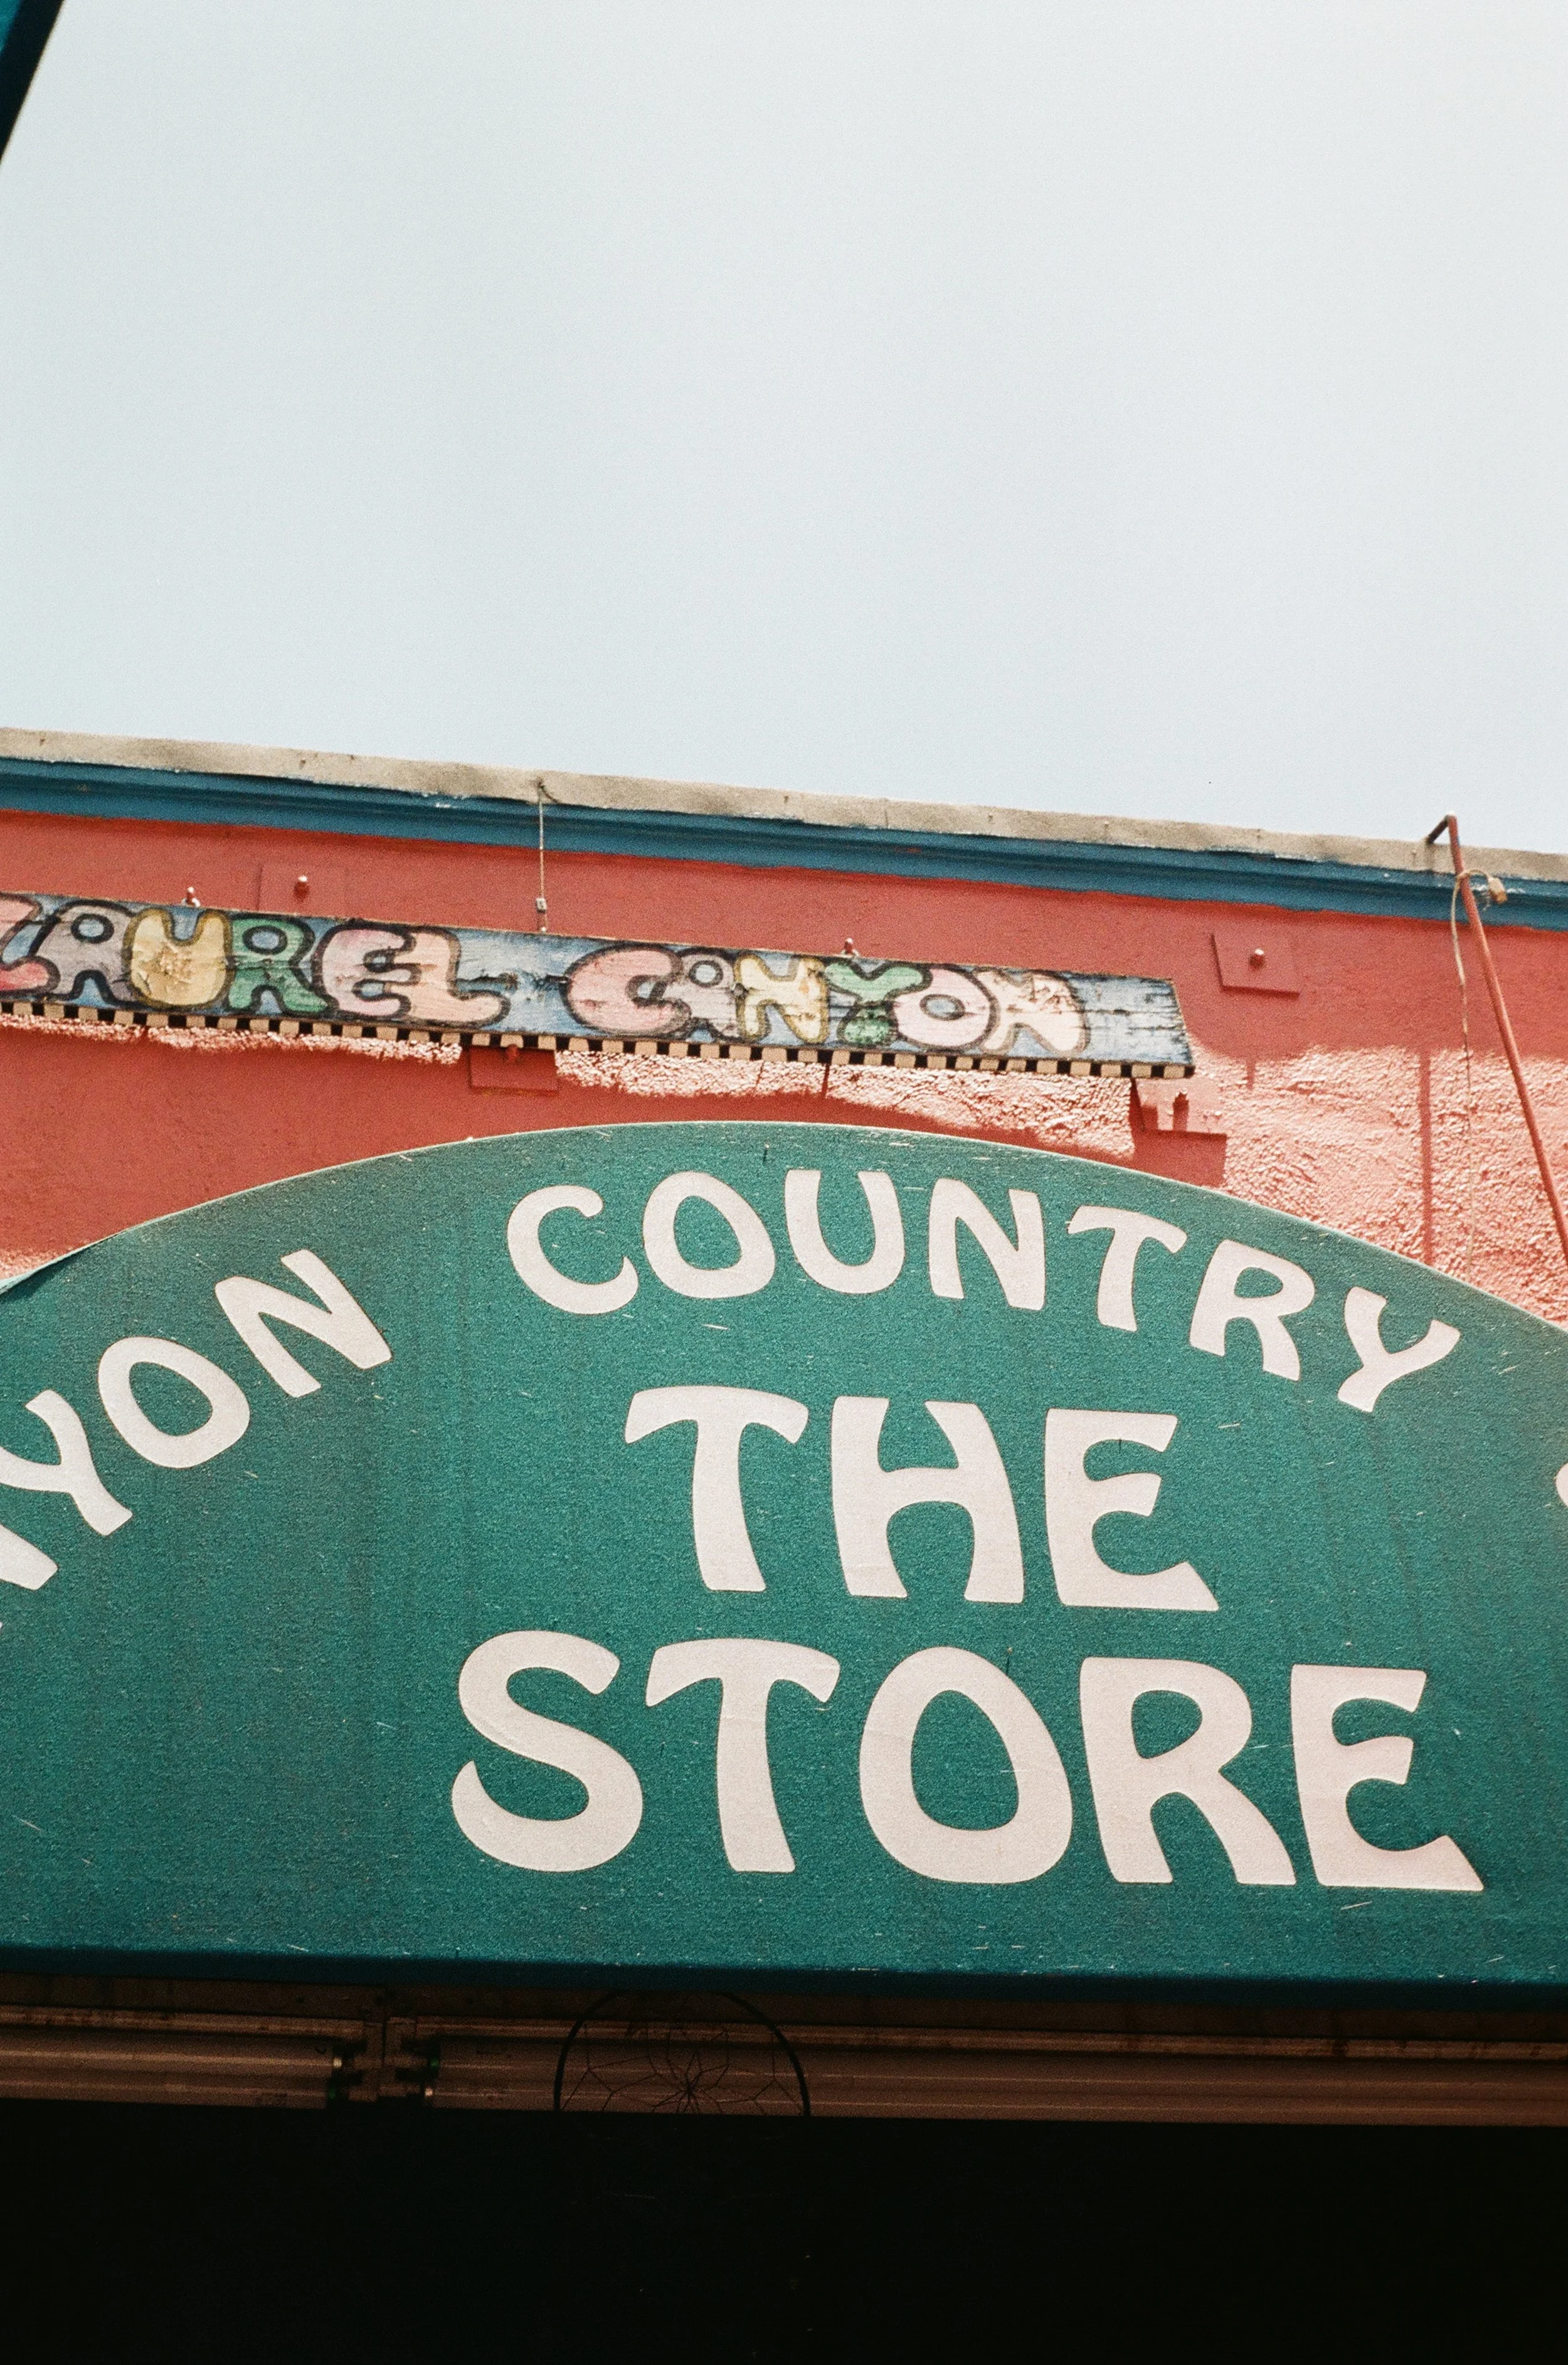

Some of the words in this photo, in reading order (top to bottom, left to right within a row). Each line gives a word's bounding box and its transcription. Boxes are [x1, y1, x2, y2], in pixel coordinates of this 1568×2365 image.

[562, 943, 1089, 1055] CANYON
[0, 1249, 392, 1590] YON
[507, 1169, 1461, 1413] COUNTRY
[625, 1385, 1219, 1612] THE
[451, 1630, 1484, 1892] STORE
